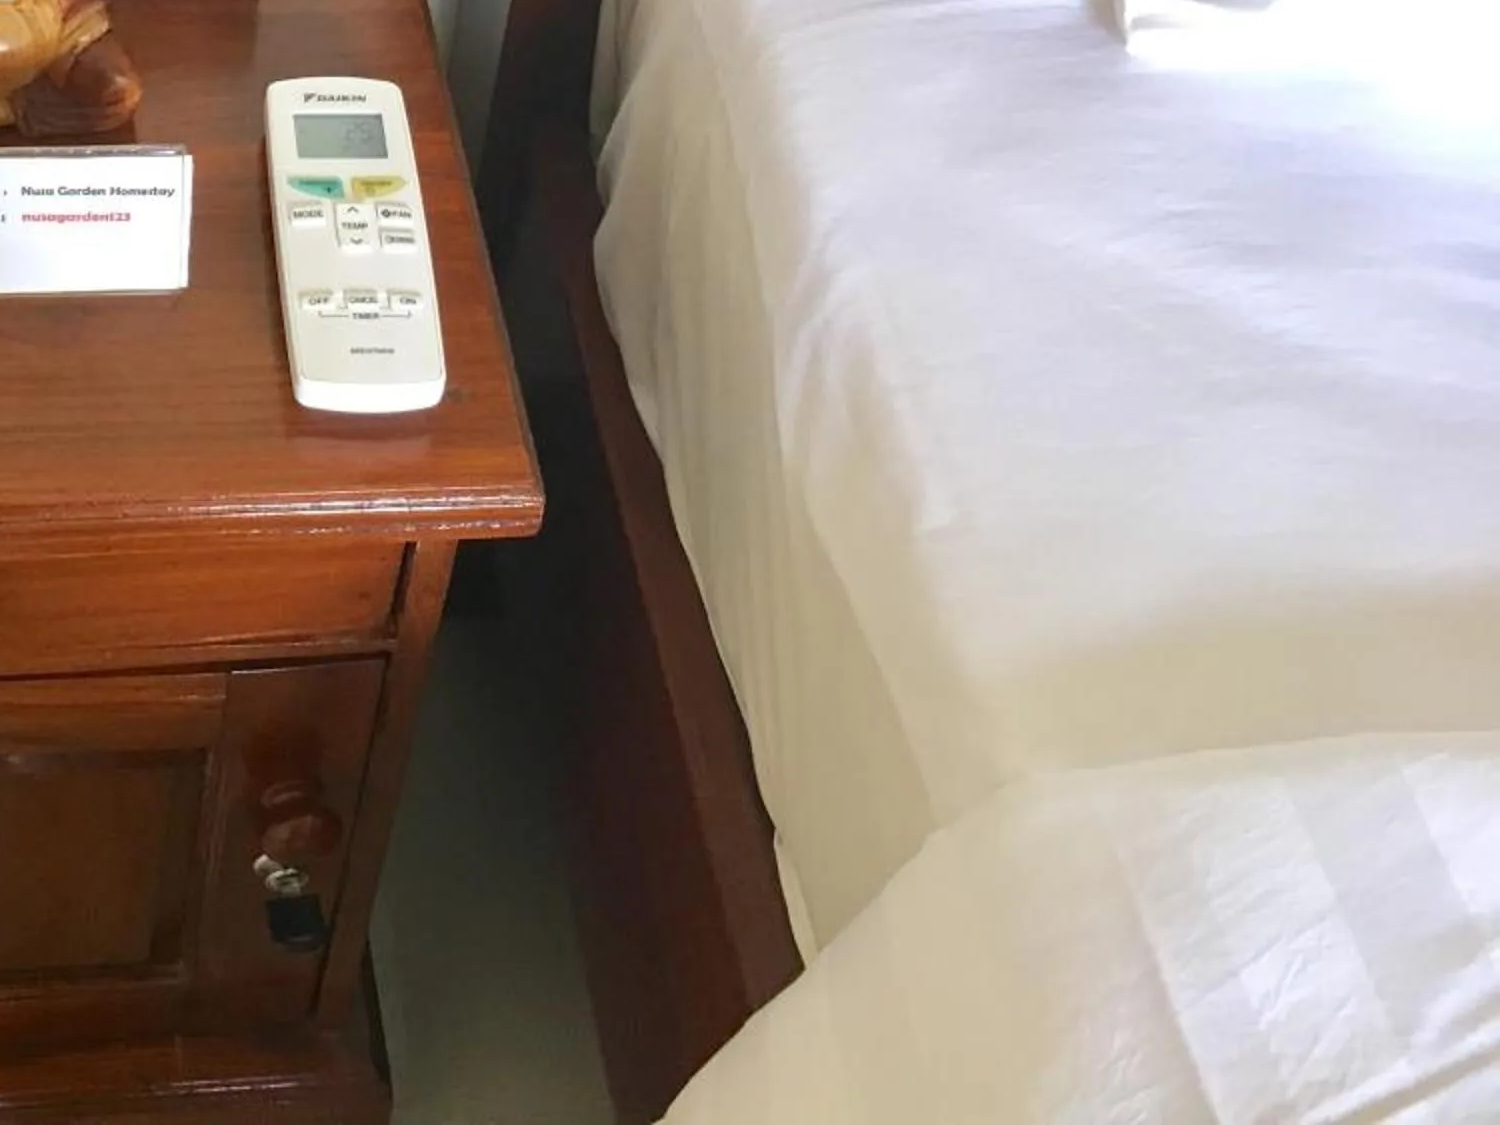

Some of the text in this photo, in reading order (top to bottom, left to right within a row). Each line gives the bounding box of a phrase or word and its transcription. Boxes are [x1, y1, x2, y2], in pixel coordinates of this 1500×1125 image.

[316, 93, 367, 103] DAIKIN
[20, 186, 54, 197] Nusa
[57, 186, 106, 197] Garden
[109, 186, 176, 199] Homestay
